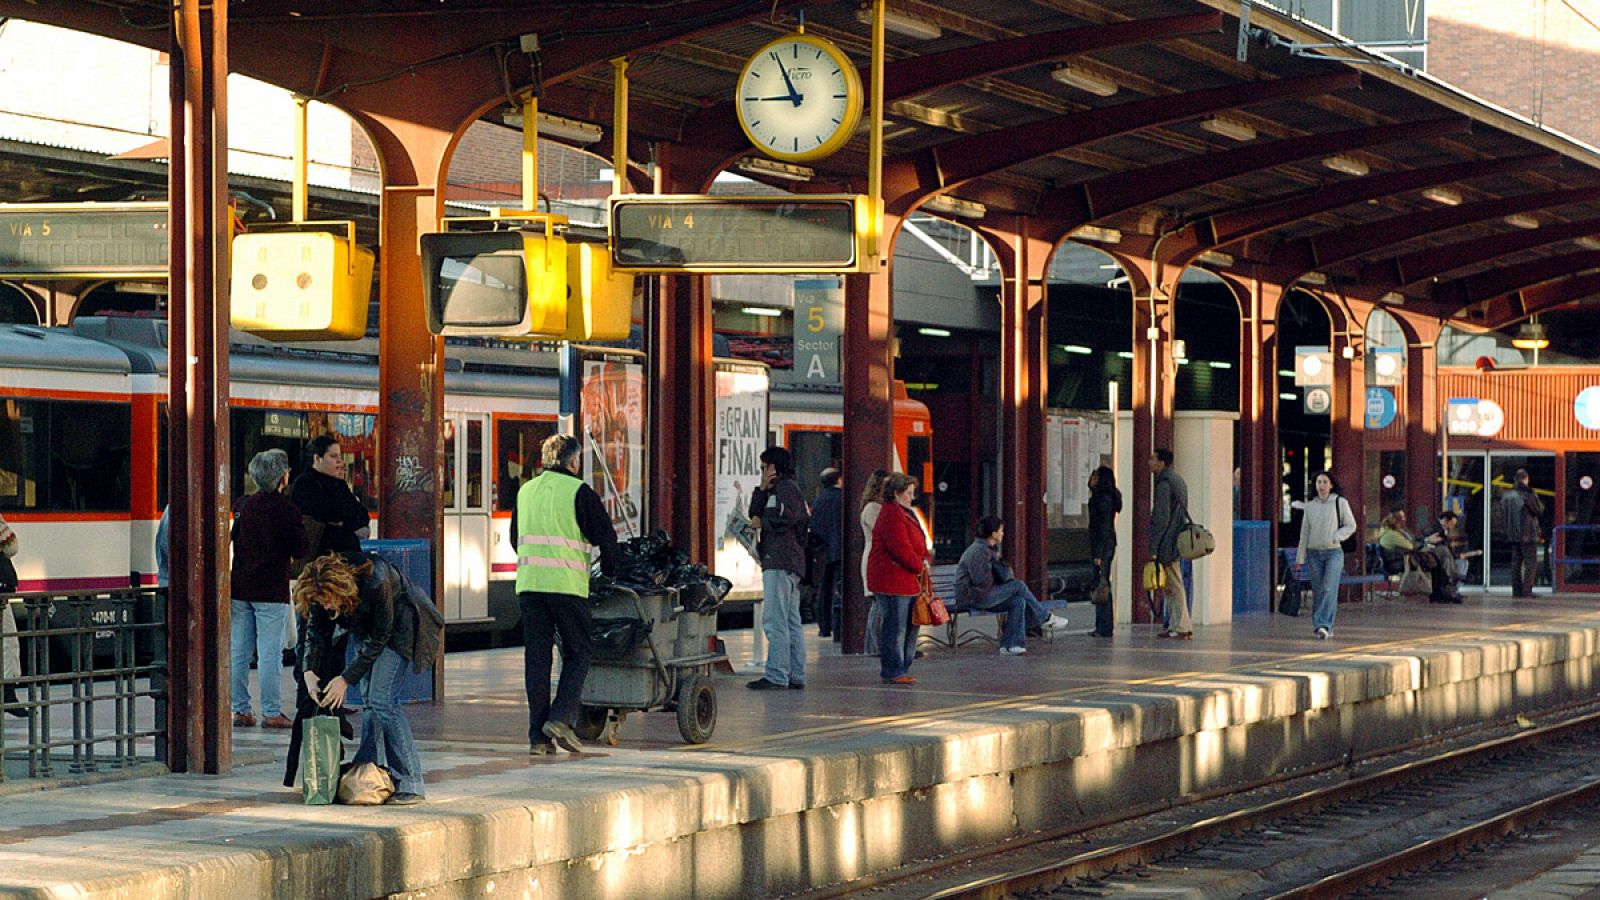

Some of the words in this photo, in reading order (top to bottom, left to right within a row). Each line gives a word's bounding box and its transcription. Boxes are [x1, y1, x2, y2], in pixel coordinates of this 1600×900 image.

[10, 223, 32, 237] VIA
[42, 221, 51, 236] 5
[648, 214, 673, 229] VIA
[683, 212, 694, 229] 4
[807, 307, 825, 333] 5
[798, 340, 834, 351] Sector
[807, 354, 825, 378] A
[726, 406, 761, 438] GRAN
[719, 439, 761, 476] FINAL
